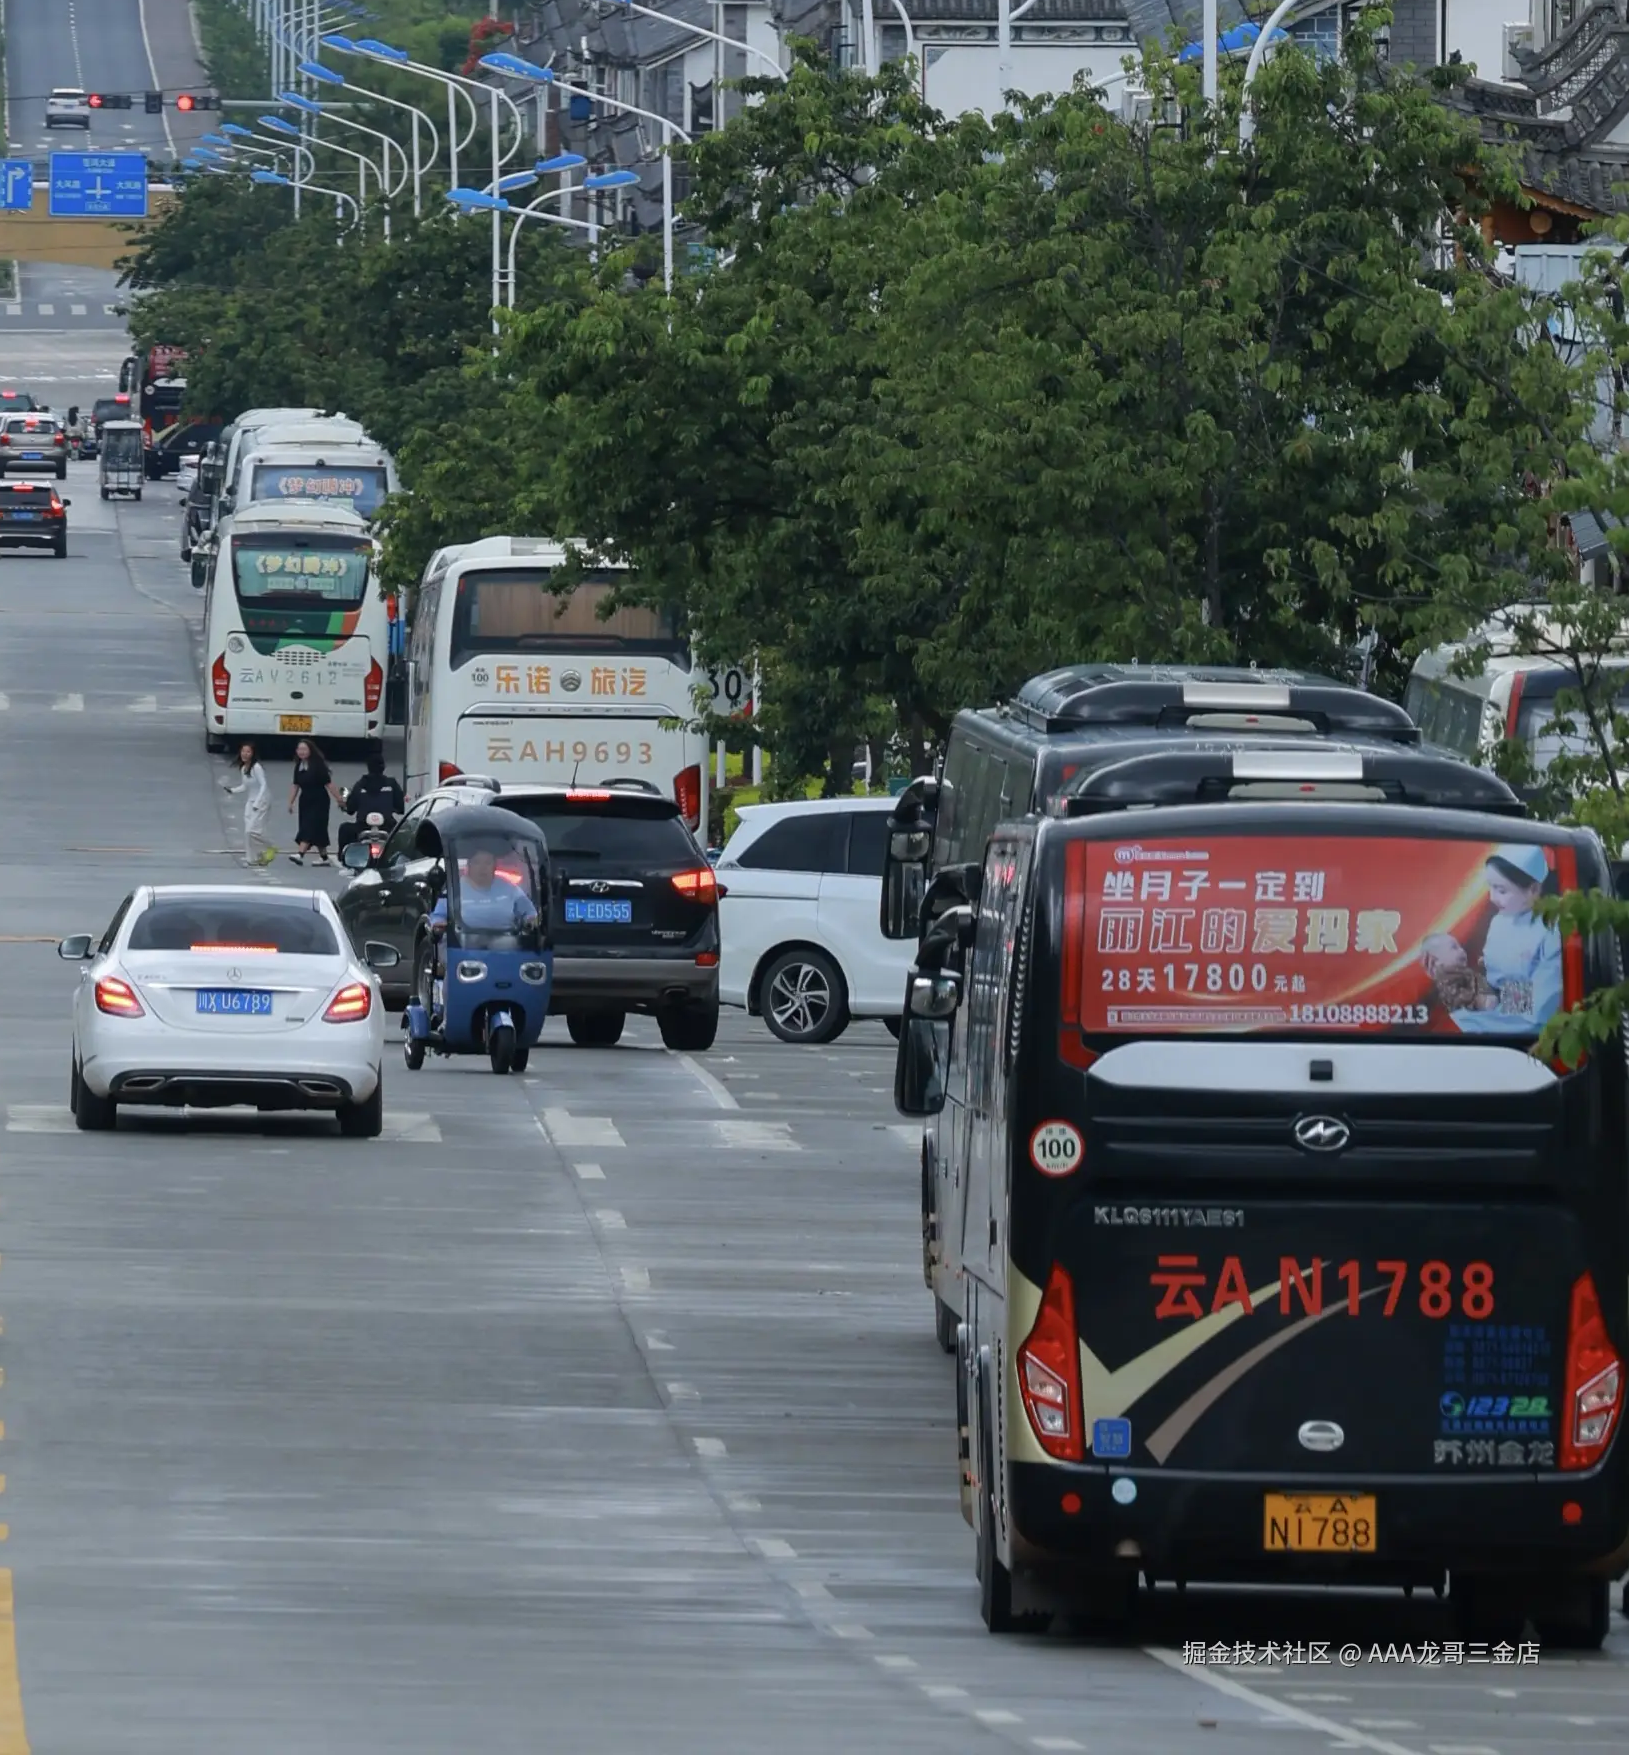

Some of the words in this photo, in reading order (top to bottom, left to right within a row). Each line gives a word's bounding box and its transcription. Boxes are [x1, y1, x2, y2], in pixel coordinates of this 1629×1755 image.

[472, 672, 489, 683] 100
[495, 665, 551, 695] 乐诺
[591, 666, 647, 697] 旅汽
[487, 738, 653, 765] 云AH9693
[1102, 869, 1326, 902] 坐月子一定到
[1097, 907, 1401, 954] 丽江的爱玛家
[1289, 1004, 1429, 1025] 18108888213
[1037, 1138, 1076, 1160] 100
[1433, 1439, 1555, 1466] 苏州金龙
[1270, 1517, 1371, 1547] N1788
